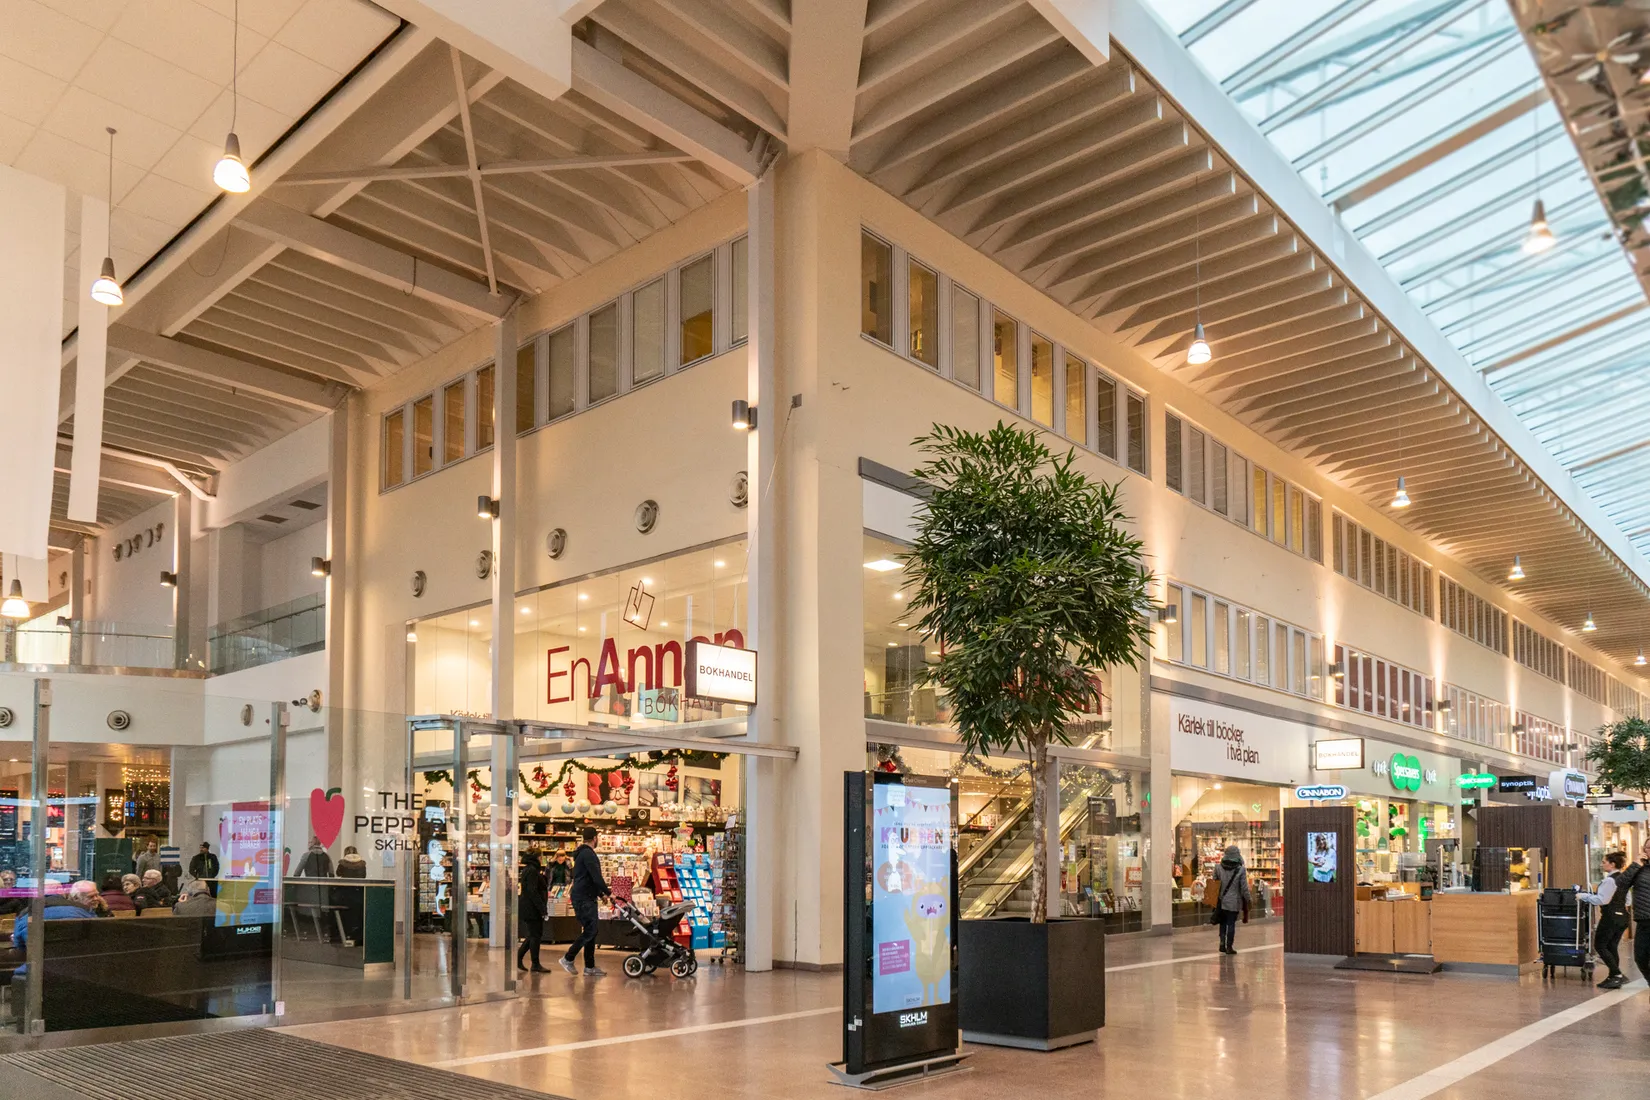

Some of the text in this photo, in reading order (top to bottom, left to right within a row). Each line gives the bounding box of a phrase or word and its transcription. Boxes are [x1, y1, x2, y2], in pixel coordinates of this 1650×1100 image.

[547, 629, 744, 704] EnAnn
[699, 665, 753, 682] BOKHANDEL
[1178, 713, 1244, 746] Kärlek till böcker,
[1226, 742, 1230, 759] i
[1230, 742, 1243, 761] två
[1318, 751, 1360, 759] BOKHANDEL
[1393, 762, 1420, 779] Specsavers
[1298, 788, 1342, 797] CINNABON
[1501, 780, 1535, 788] synoptik
[378, 791, 423, 810] THE
[374, 839, 422, 851] SKHLM
[900, 1011, 928, 1024] SKHLM
